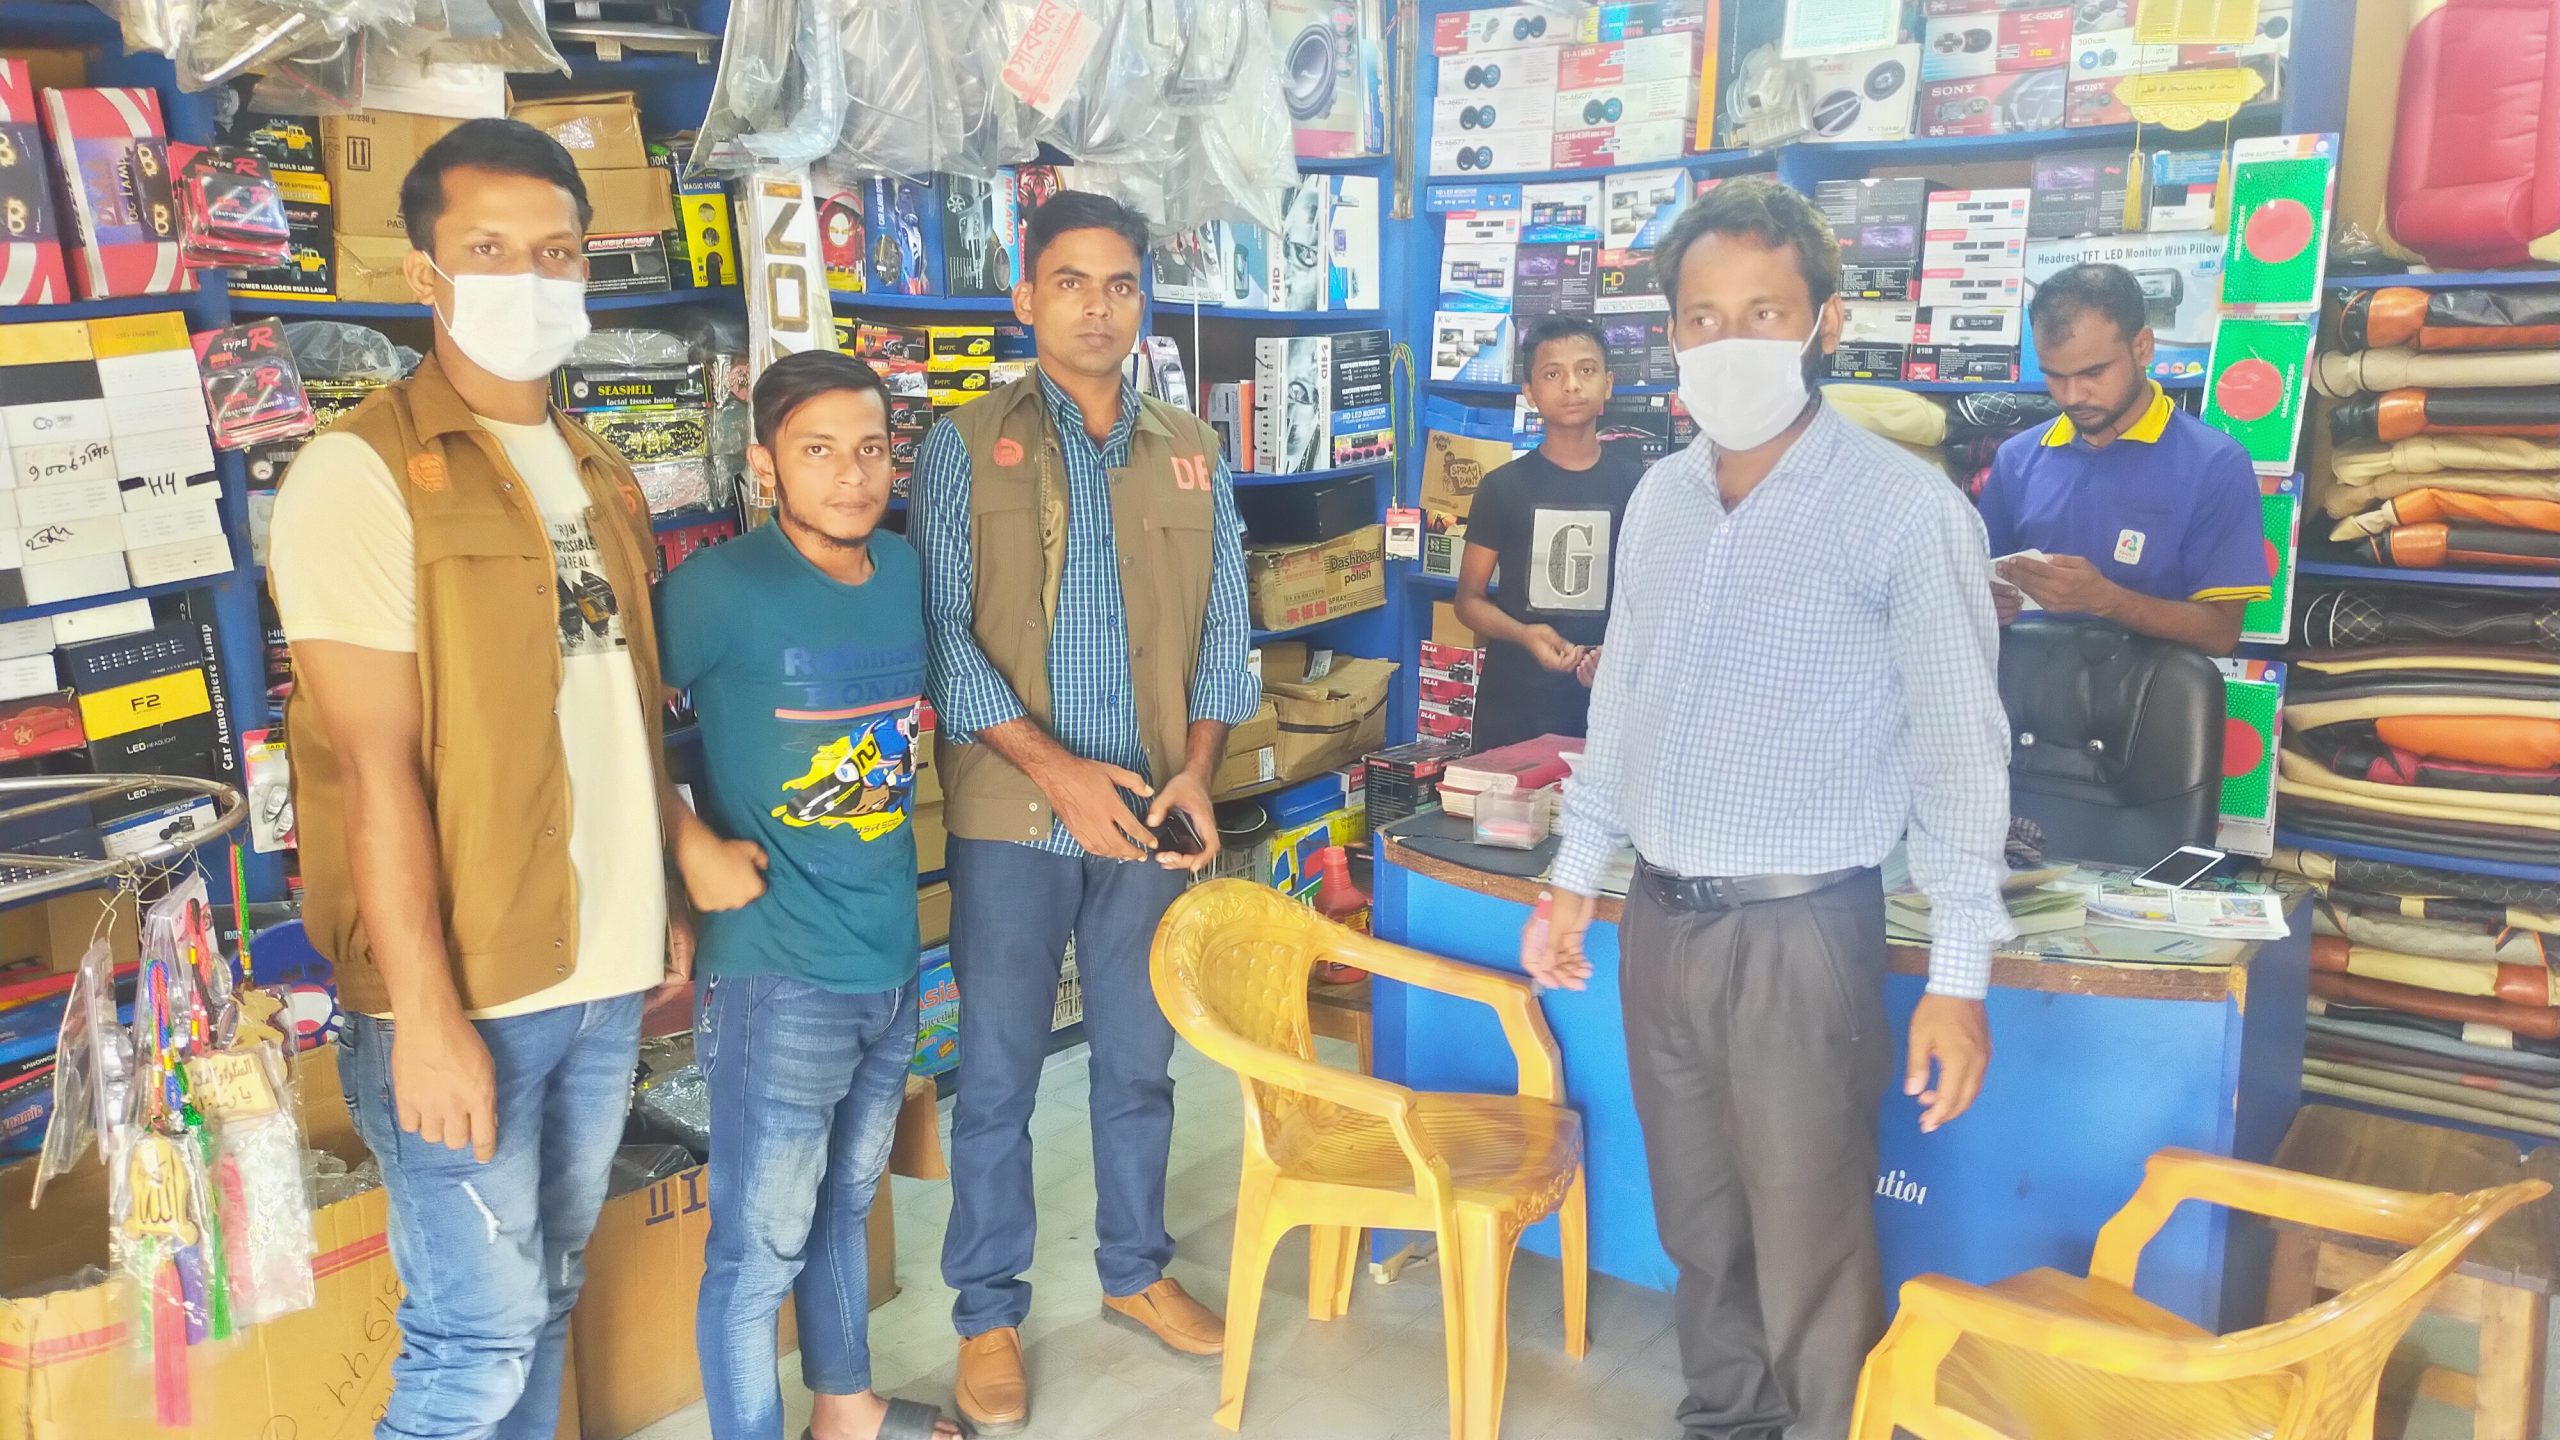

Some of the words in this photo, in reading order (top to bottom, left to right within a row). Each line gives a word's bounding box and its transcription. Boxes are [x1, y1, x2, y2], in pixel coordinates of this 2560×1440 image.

[1931, 84, 1976, 97] SONY
[2074, 82, 2105, 93] SONY
[207, 159, 232, 169] TYPE
[233, 157, 260, 177] R
[683, 181, 703, 191] MAGIC
[704, 181, 721, 190] HOSE
[1004, 175, 1015, 246] MILANO
[2038, 252, 2080, 264] Headrest
[2083, 250, 2099, 262] TFT
[2105, 248, 2123, 260] LED
[2125, 246, 2162, 258] Monitor
[2165, 245, 2187, 256] With
[2190, 243, 2221, 254] Pillow
[261, 284, 292, 292] HALOGEN
[292, 285, 309, 293] BULB
[310, 286, 328, 294] LAMP
[223, 338, 248, 351] TYPE
[249, 326, 277, 352] R
[598, 384, 654, 396] SEASHELL
[2281, 363, 2296, 419] BANGLADESH
[606, 397, 628, 406] facial
[630, 397, 652, 406] tissue
[653, 396, 678, 406] holder
[1343, 412, 1351, 420] HD
[1351, 410, 1362, 419] LED
[1363, 407, 1386, 417] MONITOR
[1451, 464, 1479, 477] SPRAY
[148, 472, 178, 497] H4
[1329, 544, 1382, 570] Dashboard
[1546, 522, 1595, 598] G
[1344, 569, 1372, 587] polish
[1328, 594, 1347, 605] SPRAY
[1329, 600, 1358, 614] BRIGHTER
[201, 623, 216, 663] Lamp
[1421, 644, 1437, 653] DLAA
[1422, 678, 1438, 687] DLAA
[131, 694, 161, 712] F2
[207, 664, 231, 748] Atmosphere
[1420, 711, 1436, 720] DLAA
[126, 742, 146, 754] LED
[146, 736, 177, 749] HEADLIGHT
[221, 750, 235, 771] Car
[127, 788, 147, 801] LED
